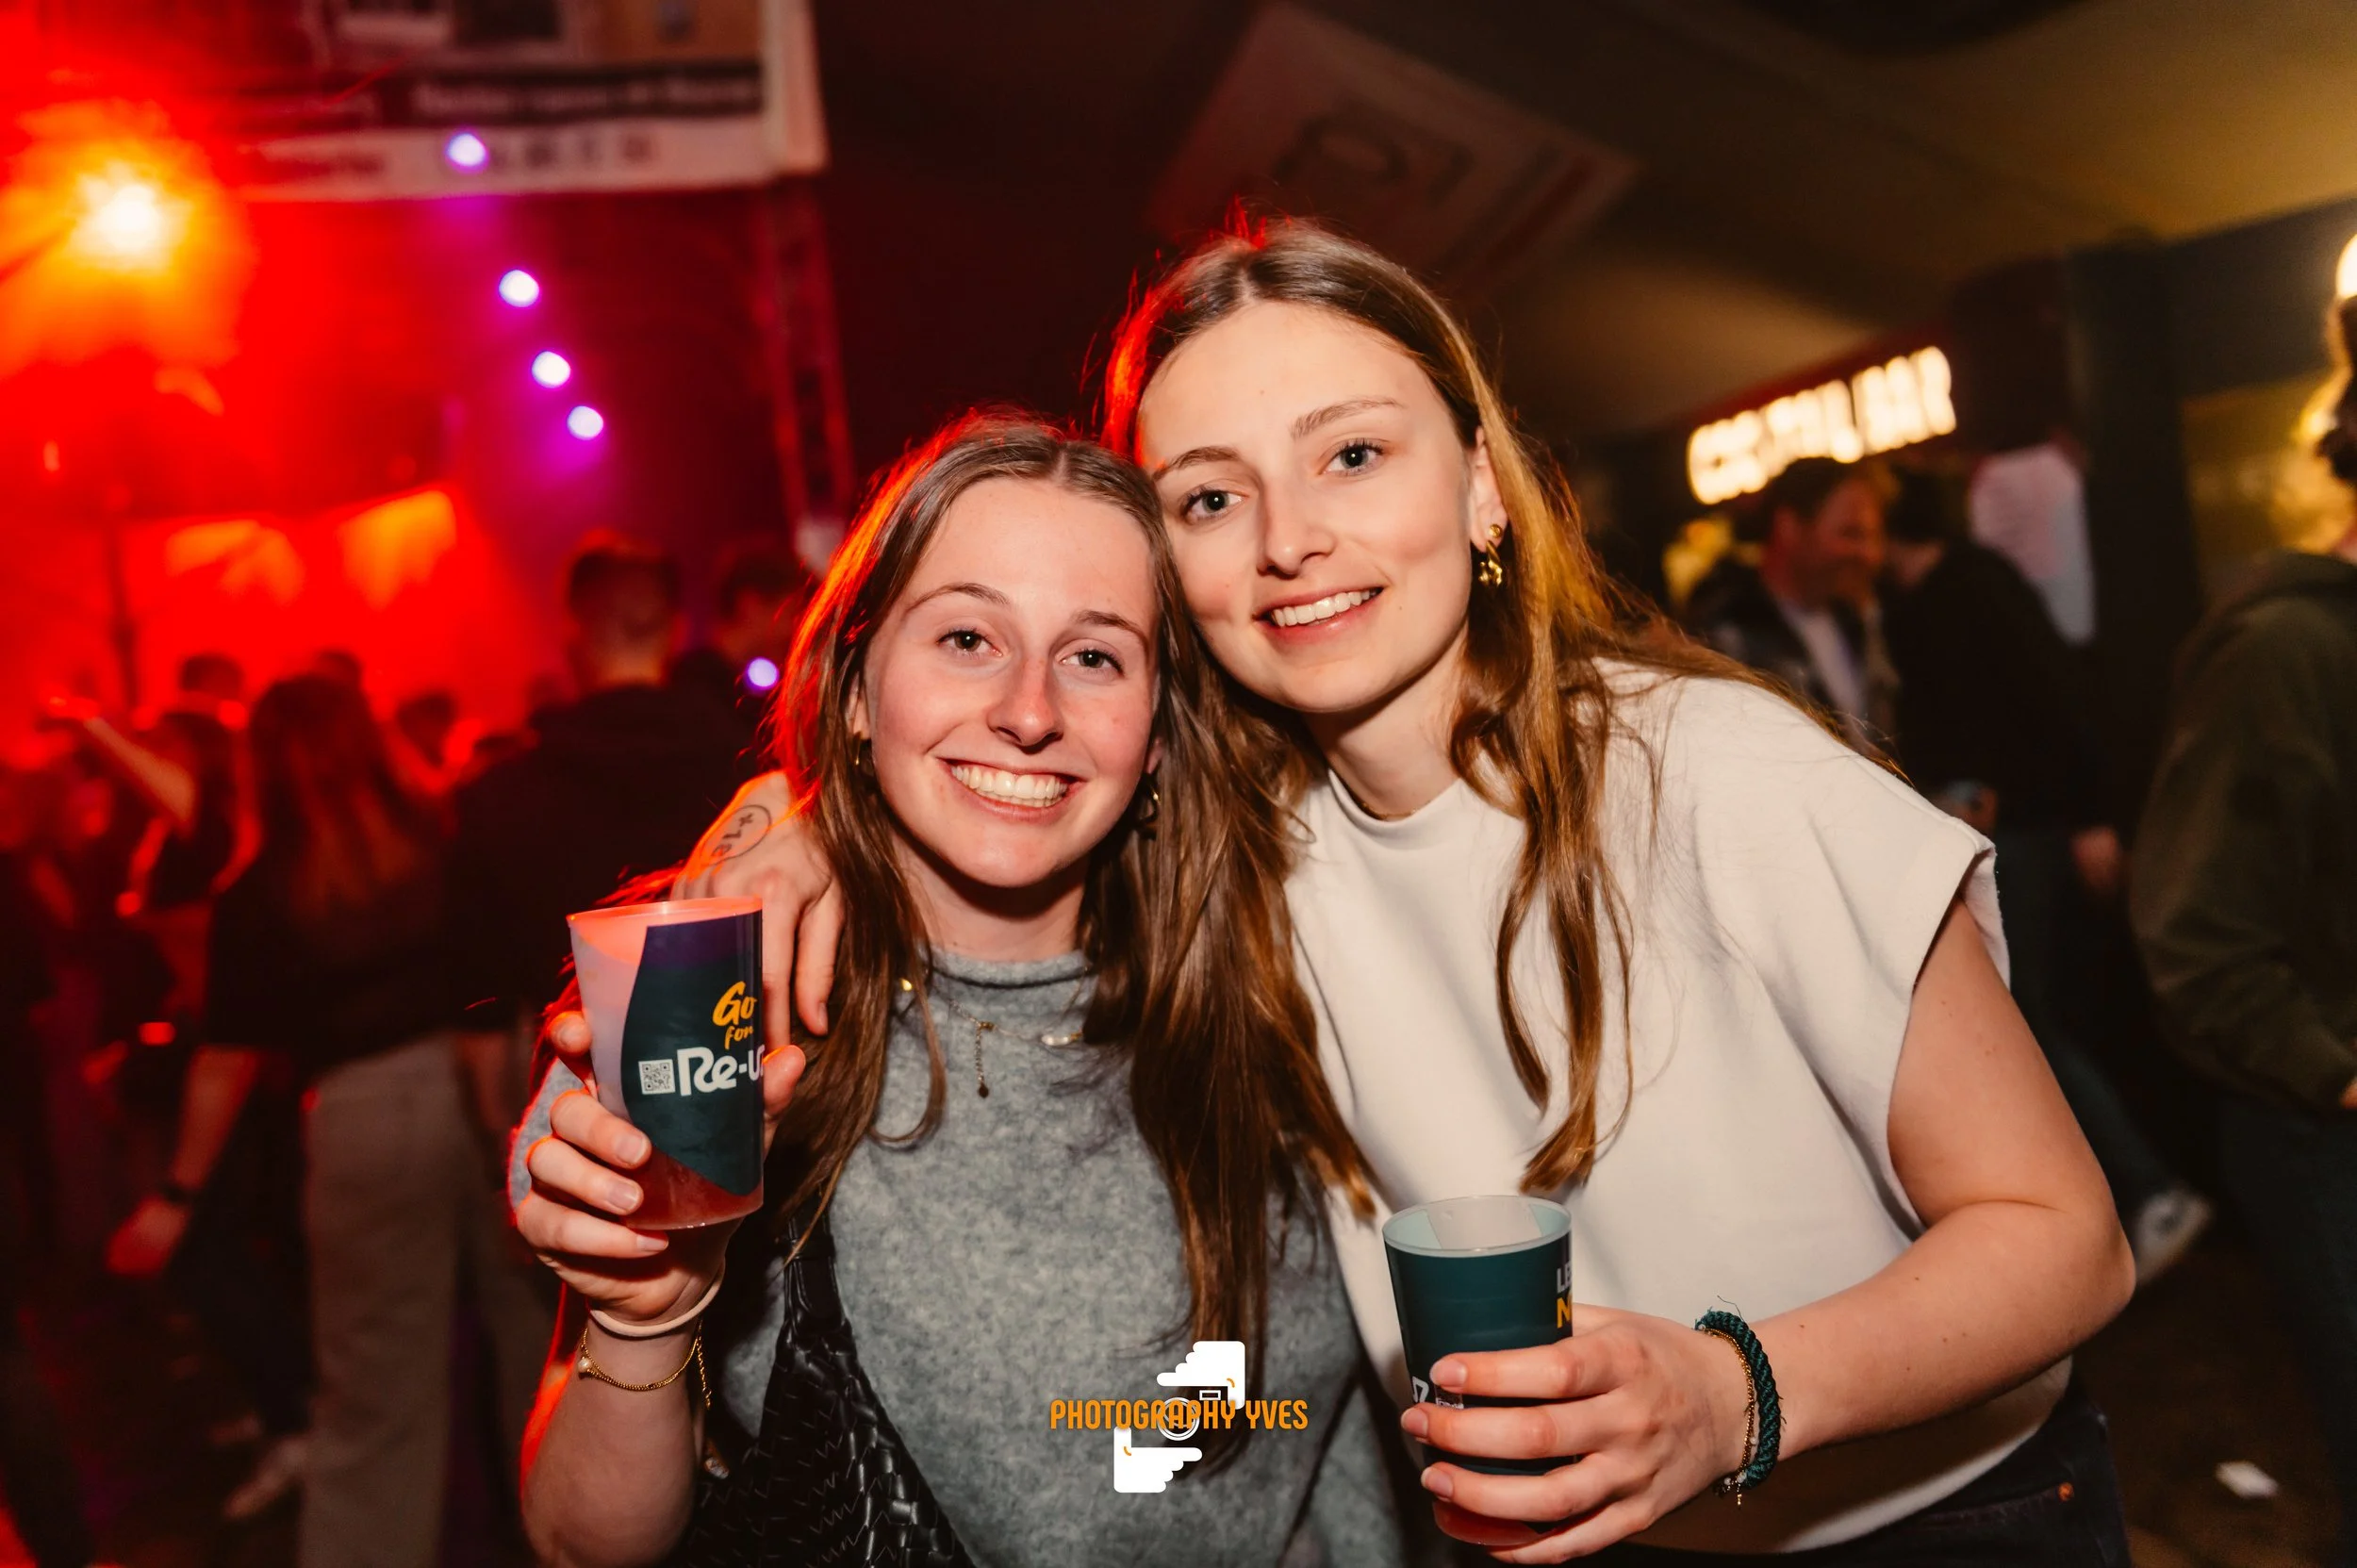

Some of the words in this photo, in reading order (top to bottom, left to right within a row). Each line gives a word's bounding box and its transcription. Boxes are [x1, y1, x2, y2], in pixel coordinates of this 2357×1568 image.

[713, 981, 757, 1026] Go
[724, 1026, 753, 1049] for
[677, 1045, 764, 1097] Re-u
